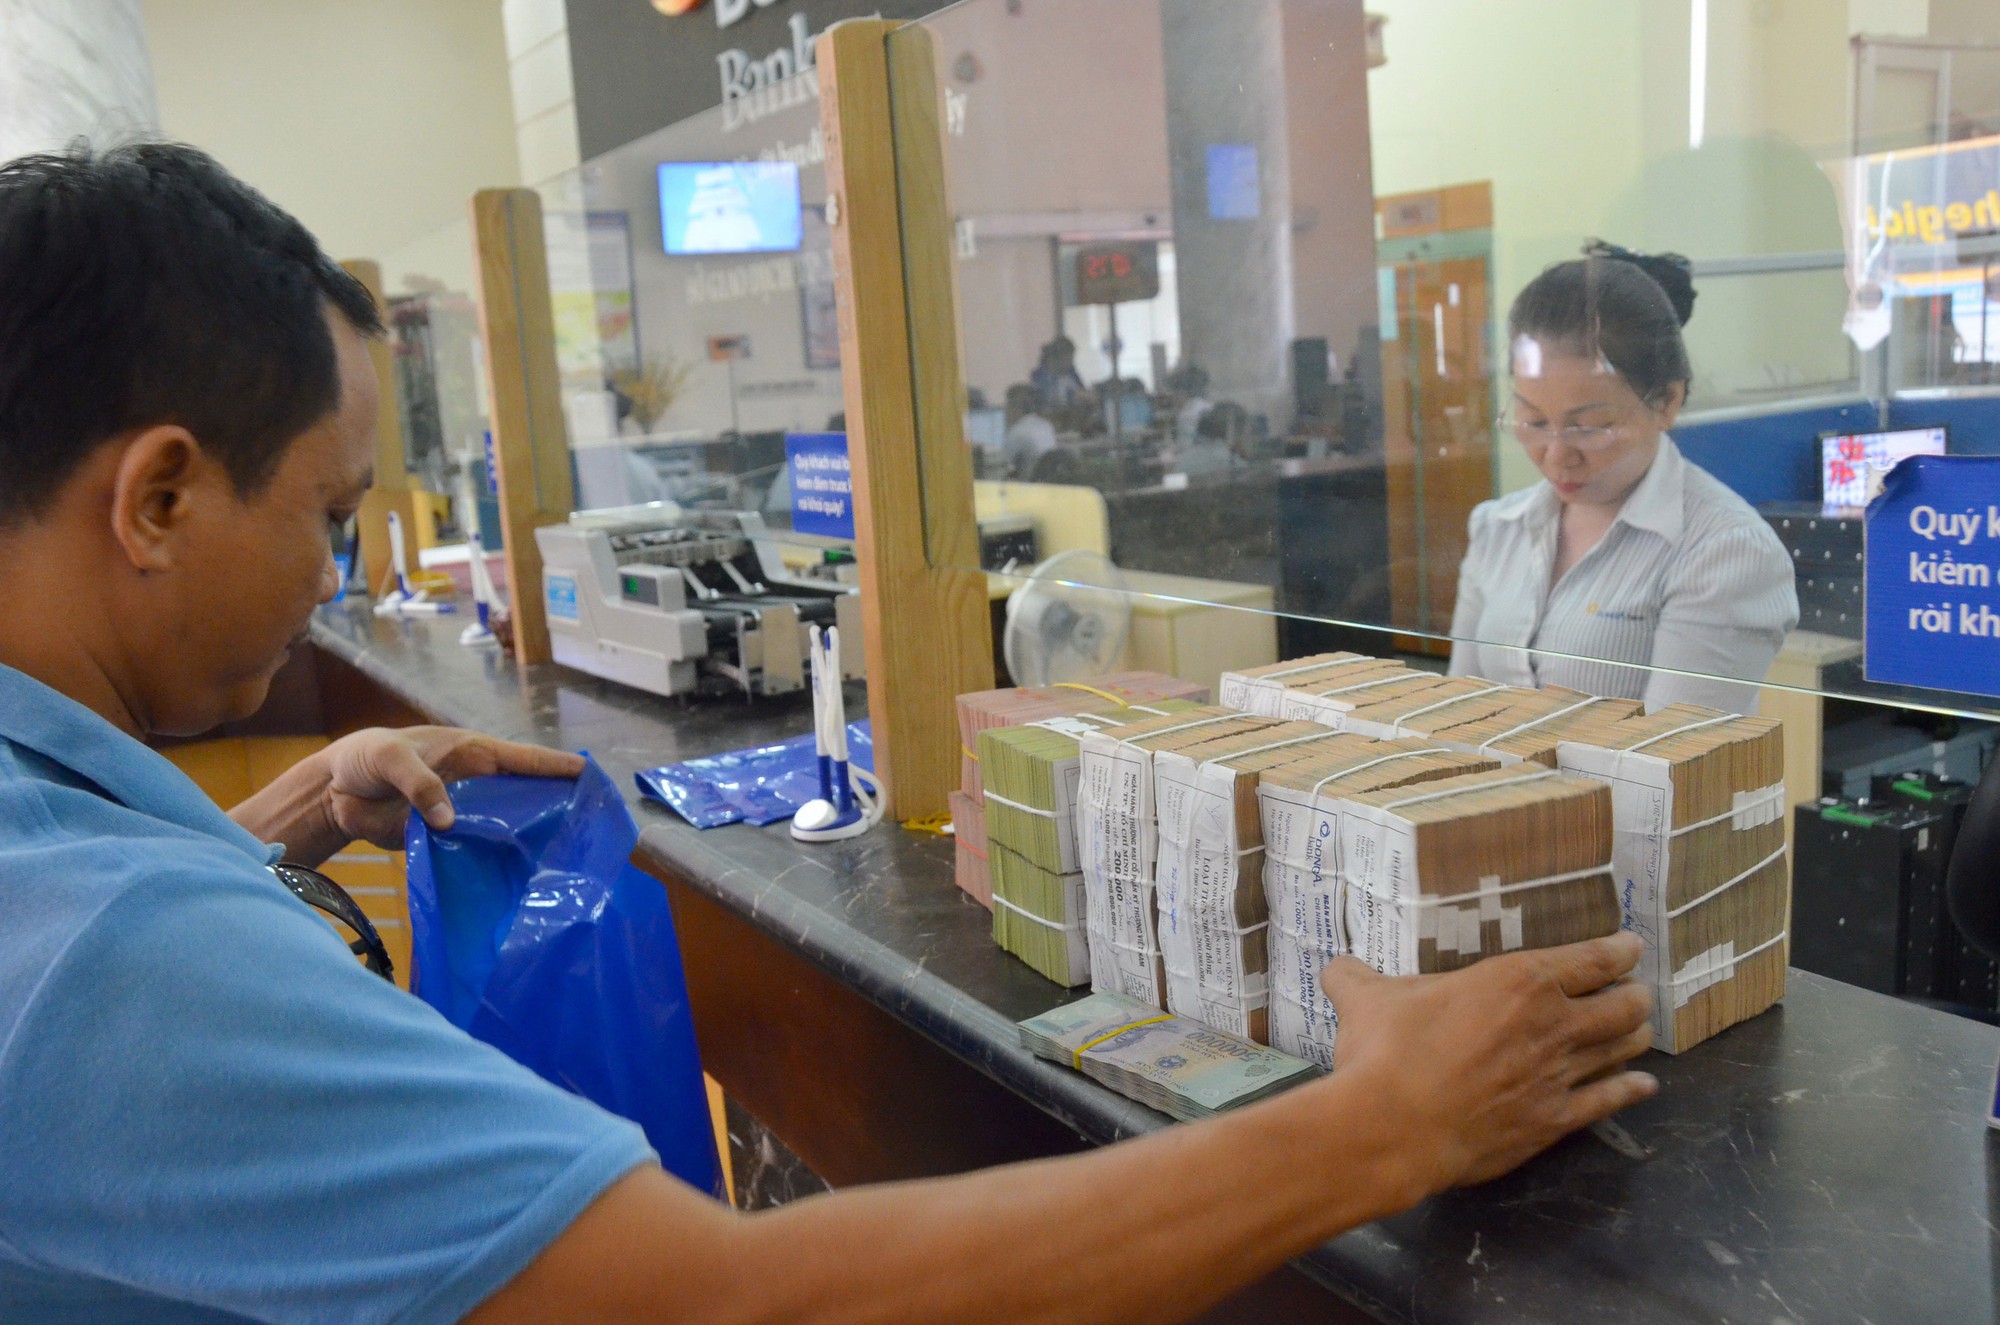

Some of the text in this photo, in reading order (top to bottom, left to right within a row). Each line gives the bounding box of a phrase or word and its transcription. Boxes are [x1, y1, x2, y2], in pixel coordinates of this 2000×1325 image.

[716, 12, 820, 131] Bank
[1909, 505, 1982, 545] Quý
[1909, 549, 1990, 587] kiểm
[1305, 836, 1316, 862] Bank
[1113, 849, 1124, 902] 200.000
